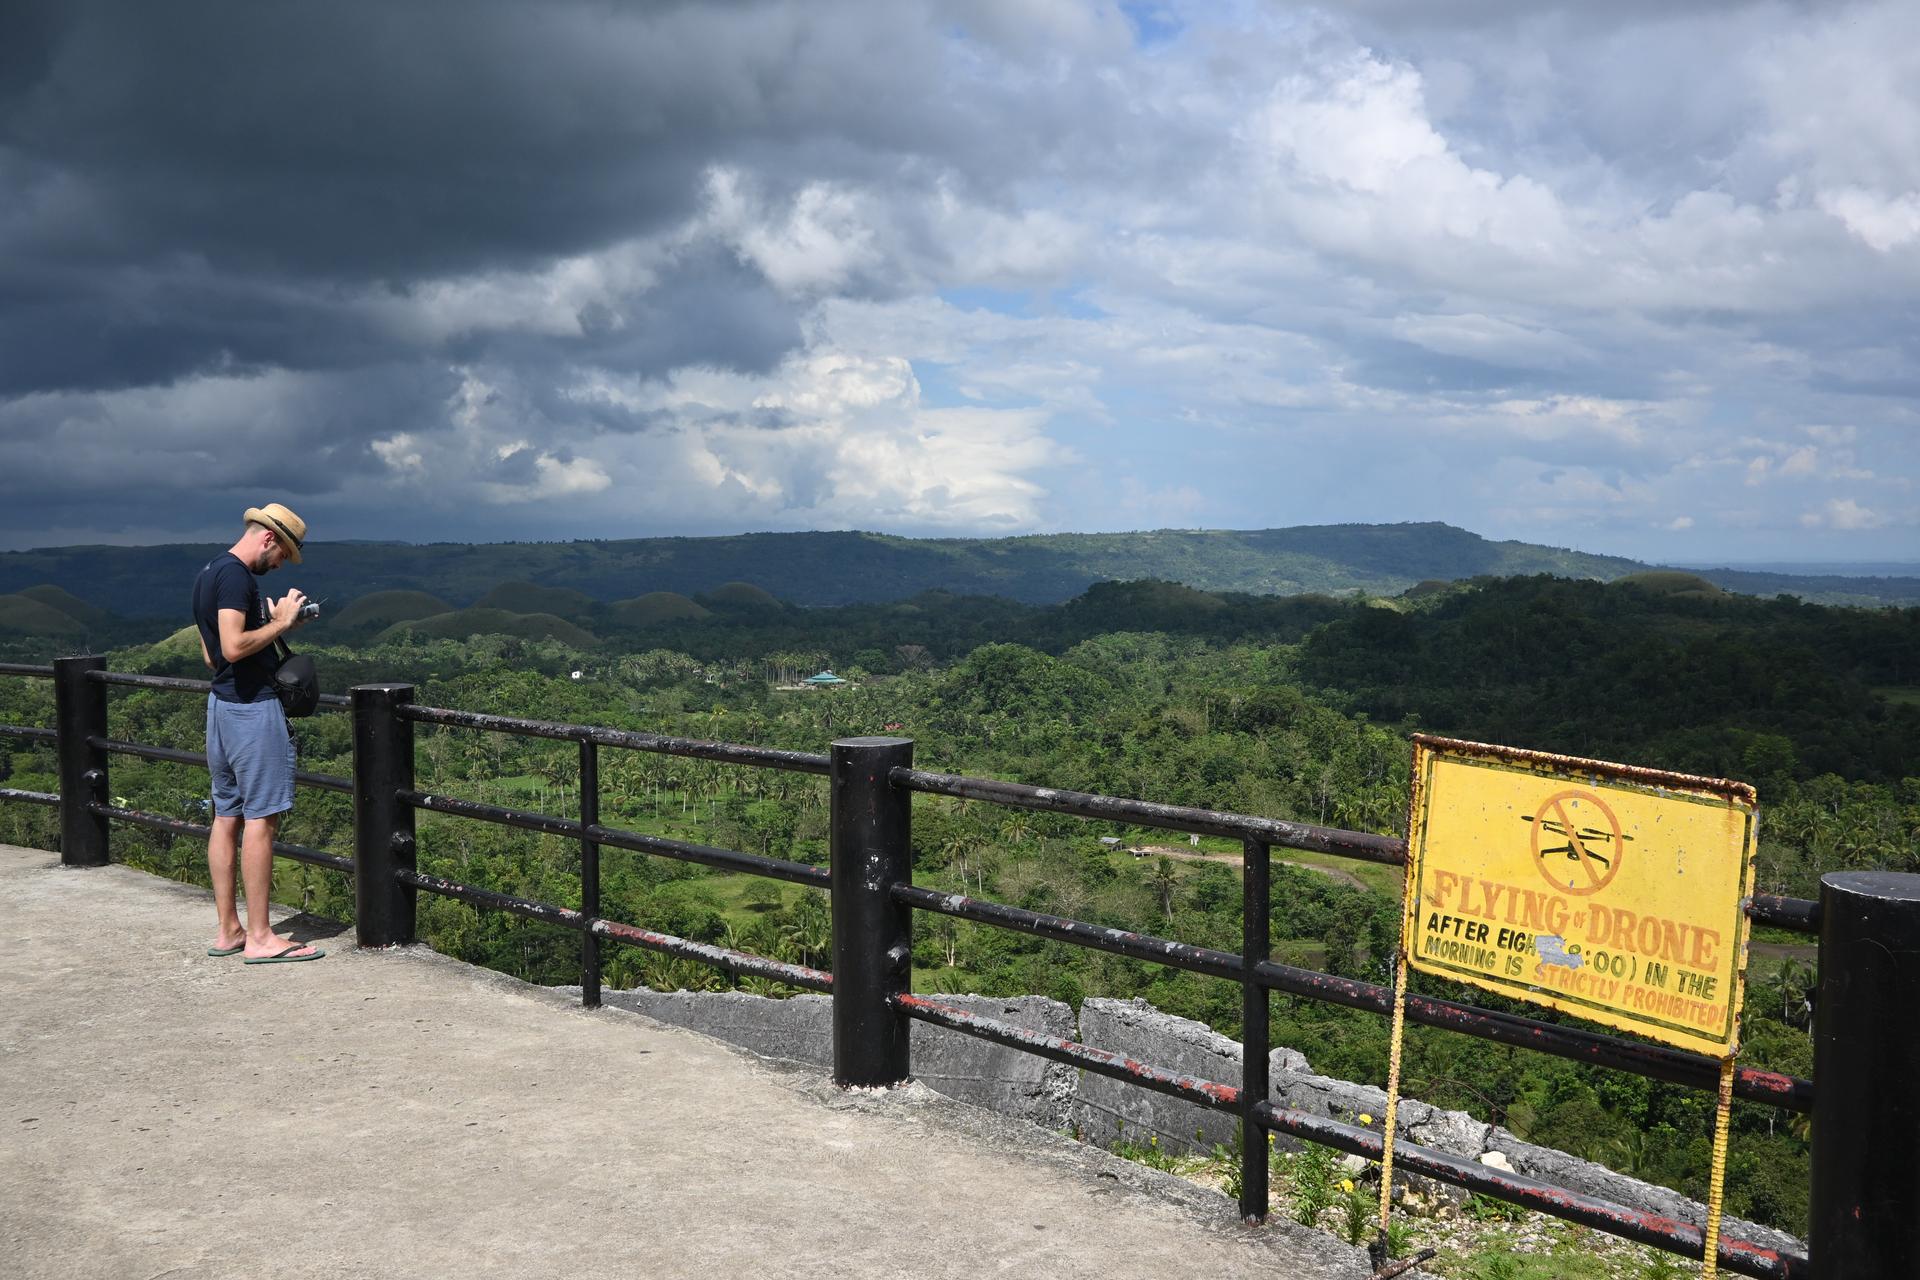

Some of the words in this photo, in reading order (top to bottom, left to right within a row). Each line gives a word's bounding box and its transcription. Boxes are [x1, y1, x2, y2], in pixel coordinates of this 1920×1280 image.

[1427, 912, 1490, 945] AFTER
[1497, 927, 1539, 957] EIGH
[1644, 961, 1669, 988] IN
[1677, 968, 1719, 1001] THE
[1431, 869, 1570, 936] FLYING
[1573, 910, 1588, 929] OF
[1585, 903, 1721, 973] DRONE
[1424, 935, 1497, 970] MORNING
[1504, 954, 1524, 977] IS
[1533, 962, 1620, 1001] STRICTLY
[1622, 984, 1728, 1031] PROHIBITED!
